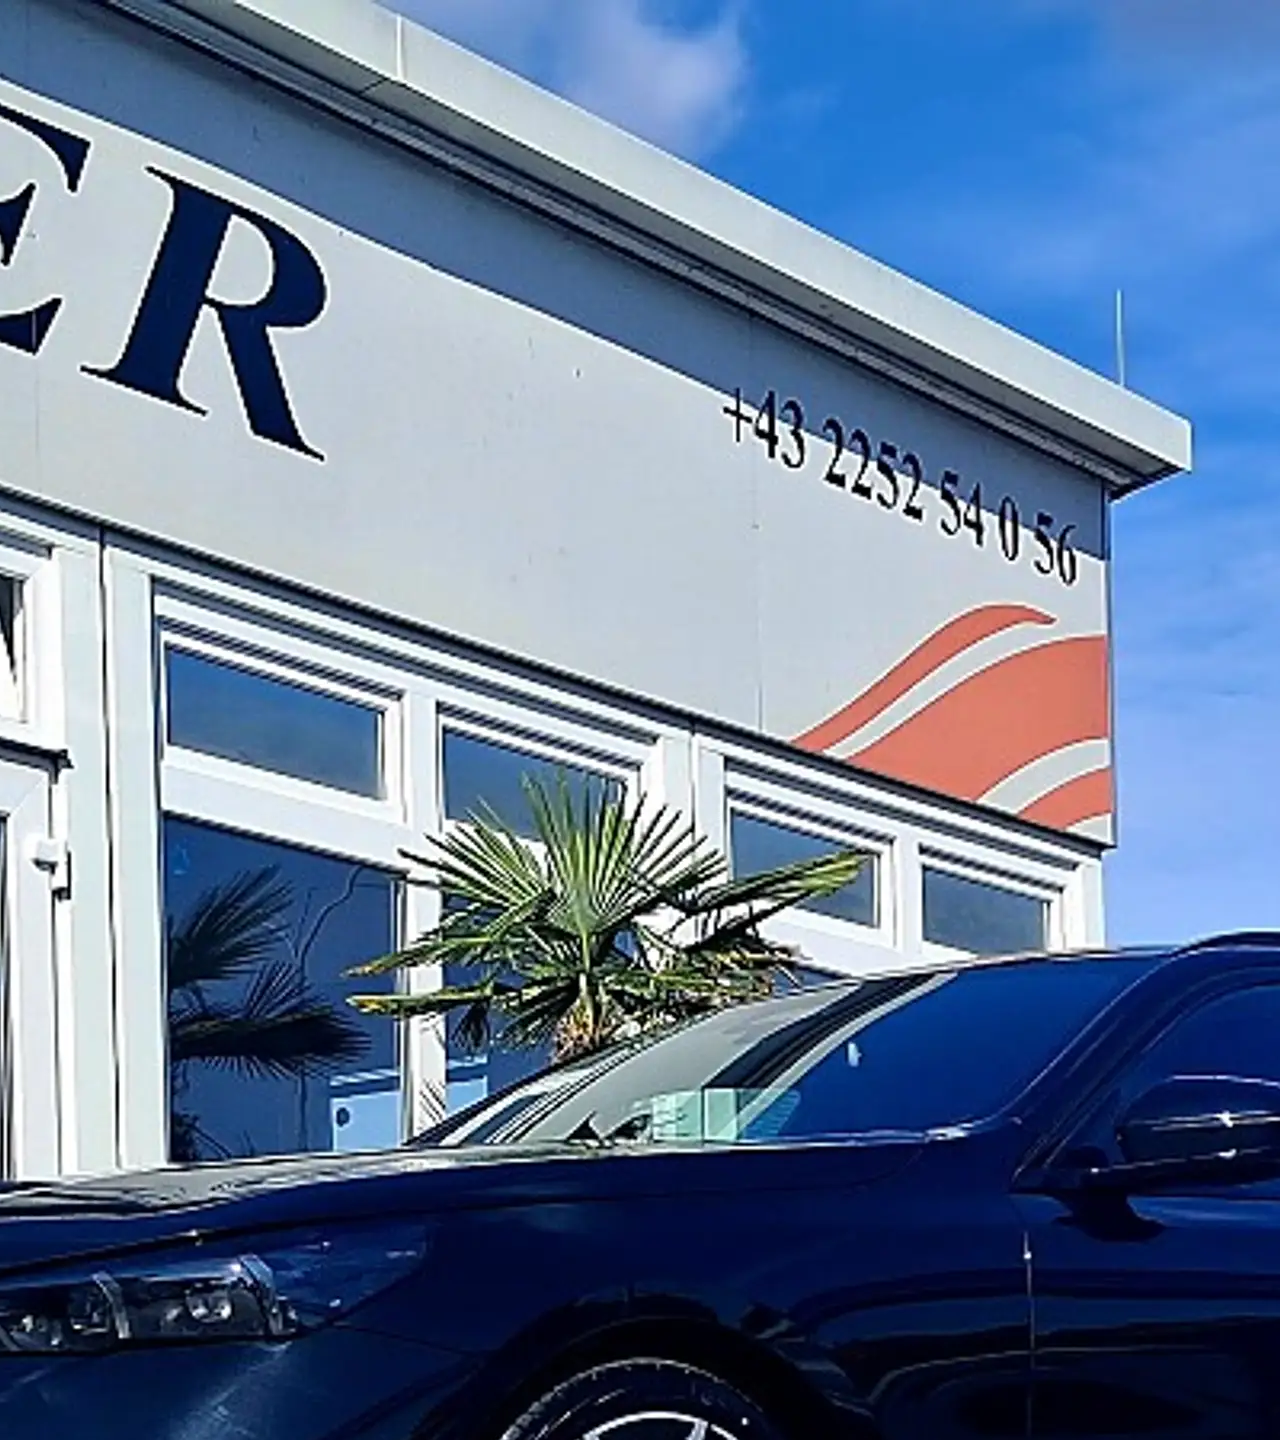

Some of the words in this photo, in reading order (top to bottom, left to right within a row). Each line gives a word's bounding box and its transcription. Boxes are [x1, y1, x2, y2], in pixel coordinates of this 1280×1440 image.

[722, 387, 806, 469] +43
[823, 417, 924, 523] 2252
[940, 468, 984, 548] 54
[998, 496, 1020, 561] 0
[1034, 511, 1078, 587] 56
